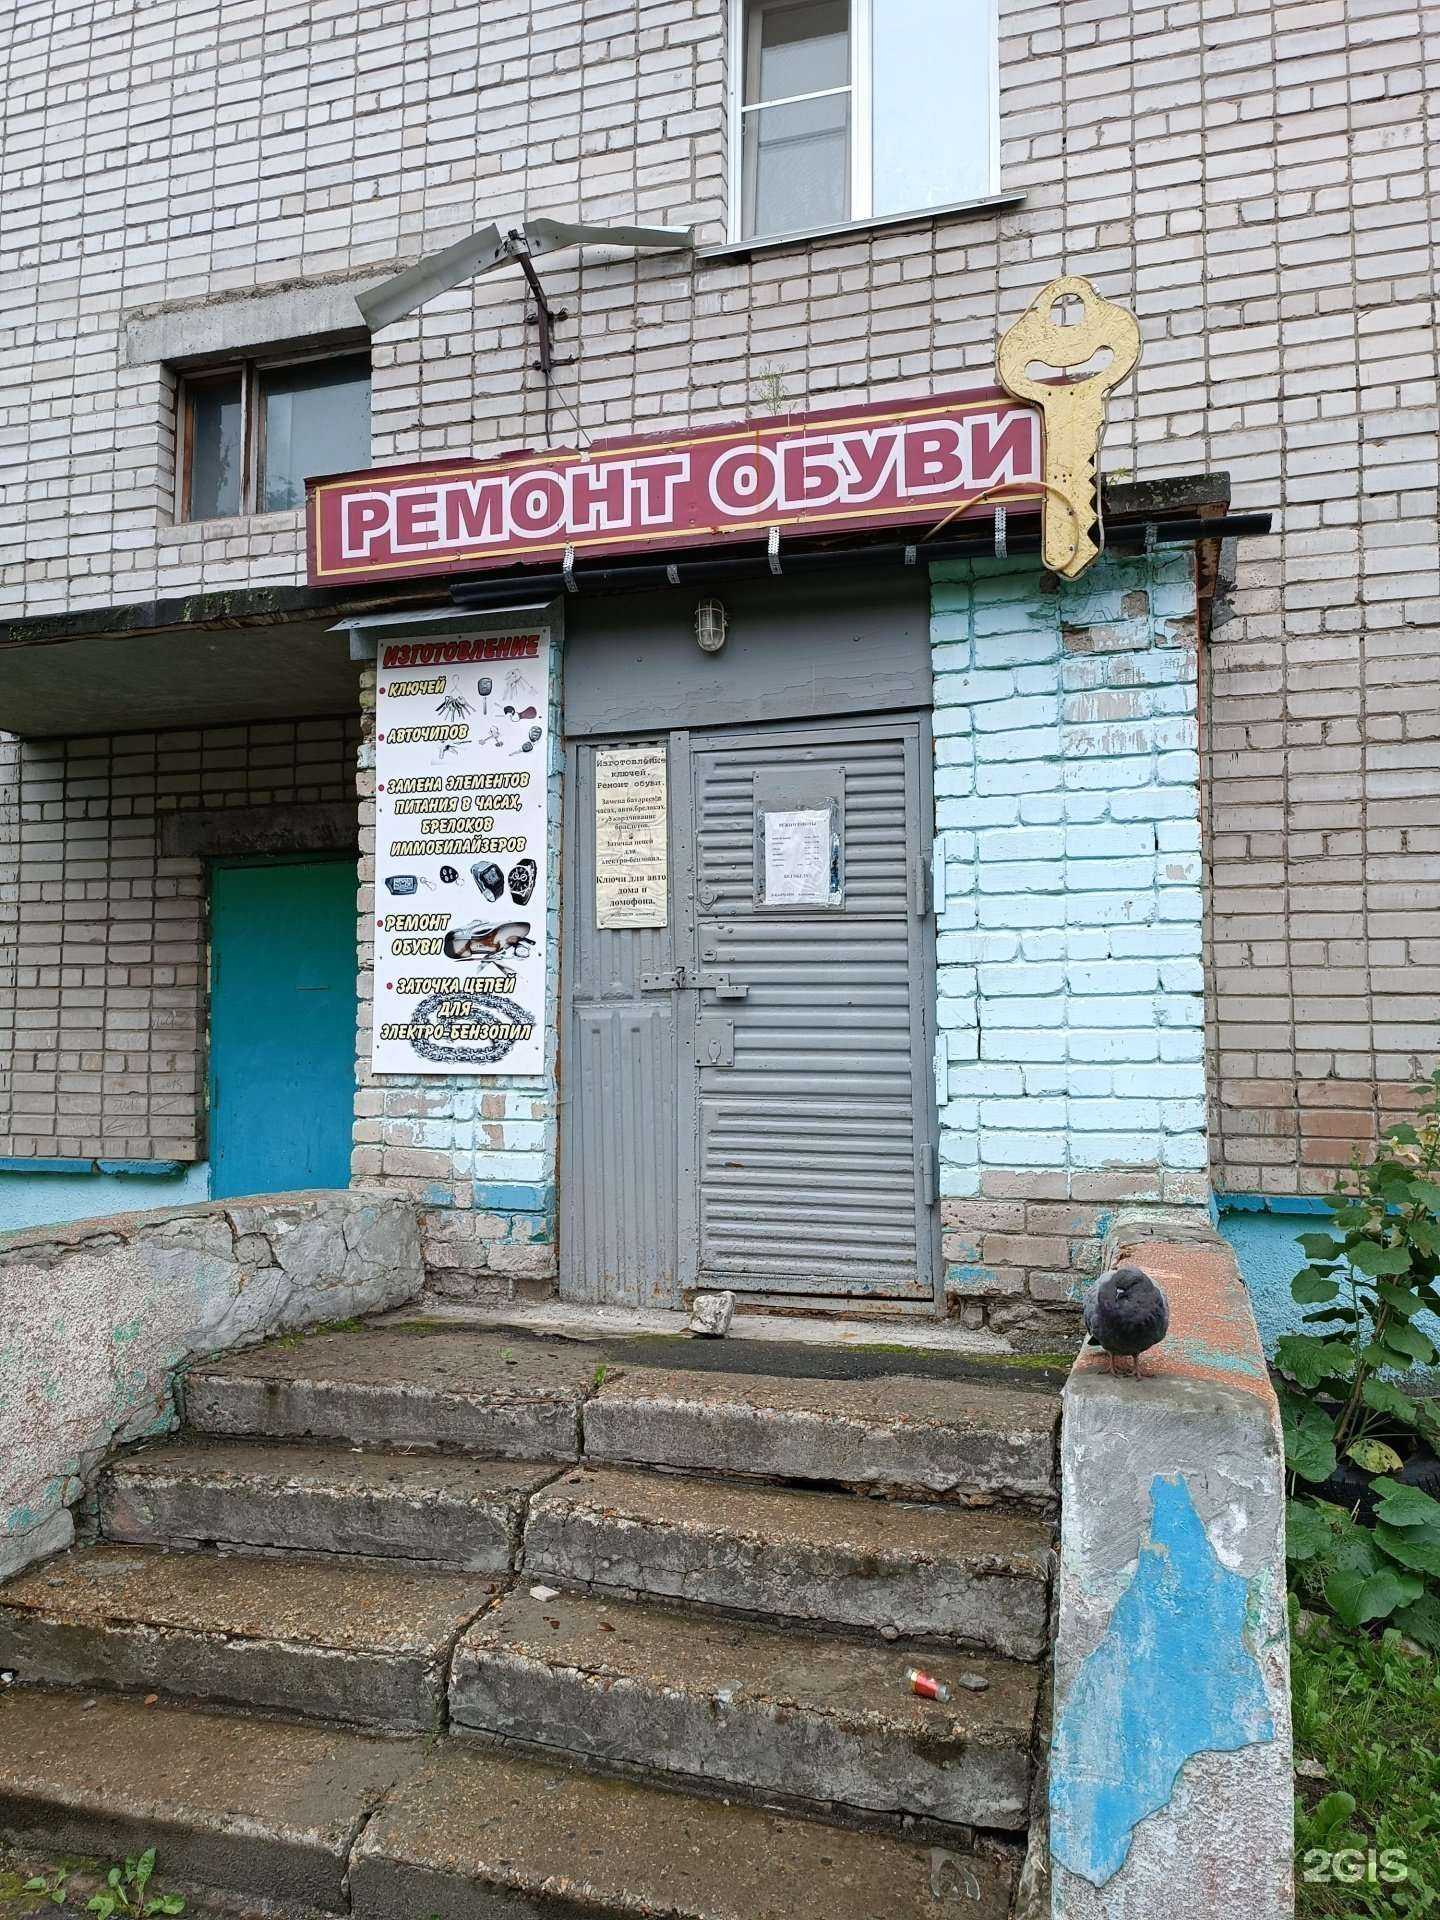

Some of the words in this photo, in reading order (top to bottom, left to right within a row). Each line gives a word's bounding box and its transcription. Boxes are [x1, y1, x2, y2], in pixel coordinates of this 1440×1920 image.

[341, 453, 690, 559] РЕМОНТ
[709, 407, 1042, 517] ОБУВИ
[383, 635, 540, 667] ИЗГОТОВЛЕНИЕ
[388, 676, 446, 697] КЛЮЧЕЙ
[387, 724, 469, 744] АВТОЧИПОВ
[387, 777, 442, 794] ЗАМЕНА
[446, 773, 530, 791] ЭЛЕМЕНТОВ
[395, 797, 459, 814] ПИТАНИЯ
[461, 796, 471, 811] В
[475, 794, 522, 811] ЧАСАХ,
[421, 817, 494, 834] БРЕЛОКОВ
[390, 834, 527, 856] ИММОБИЛАЙЗЕРОВ
[596, 875, 626, 885] Ключи
[385, 914, 451, 932] РЕМОНТ
[392, 938, 444, 955] ОБУВИ
[396, 977, 460, 994] ЗАТОЧКА
[463, 973, 517, 994] ЦЕПЕЙ
[438, 1001, 472, 1018] ДЛЯ
[380, 1024, 532, 1040] ЭЛЕКТРО-БЕНЗОПИЛ
